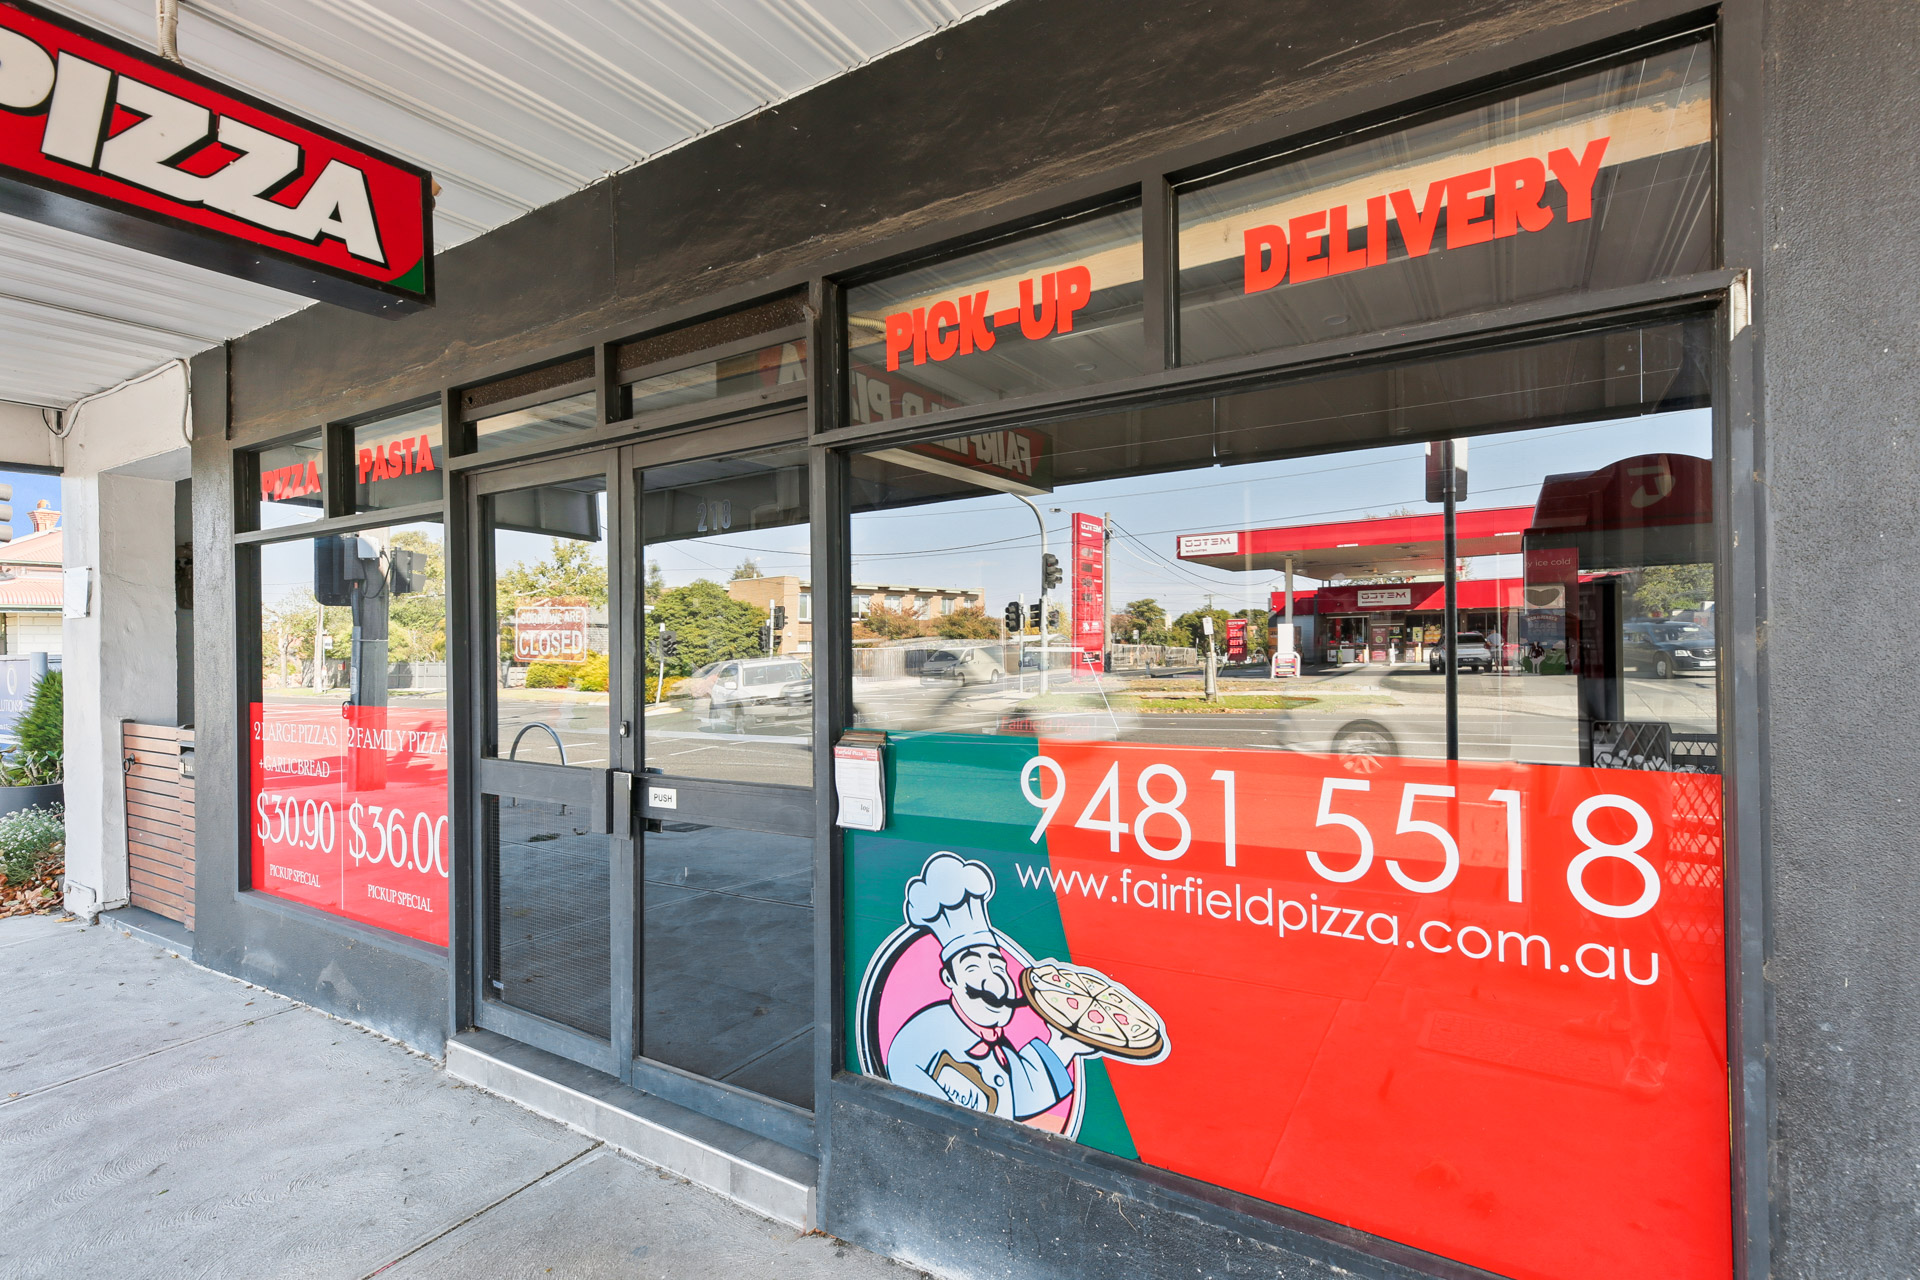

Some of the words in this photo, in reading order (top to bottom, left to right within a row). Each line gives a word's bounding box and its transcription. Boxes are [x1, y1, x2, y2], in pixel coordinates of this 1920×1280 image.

[1244, 136, 1611, 295] DELIVERY
[885, 265, 1092, 372] PICK-UP
[359, 434, 435, 485] PASTA
[261, 461, 322, 503] PIZZA
[1535, 559, 1549, 567] ice
[1550, 558, 1571, 566] cold
[521, 612, 548, 625] SORRY
[549, 612, 563, 625] WE
[564, 610, 581, 623] ARE
[519, 630, 583, 656] CLOSED
[253, 721, 262, 741] 2
[263, 722, 298, 744] LARGE
[298, 723, 337, 746] PIZZAS
[1001, 716, 1052, 731] Fairfield
[347, 726, 356, 748] 2
[356, 727, 406, 753] FAMILY
[297, 758, 330, 778] BREAD
[653, 793, 672, 803] PUSH
[256, 787, 336, 854] $30.90
[1020, 755, 1237, 868] 9481
[1305, 776, 1662, 919] 5518
[292, 868, 322, 888] SPECIAL
[396, 890, 433, 913] SPECIAL
[1014, 861, 1660, 986] www.fairfieldpizza.com.au
